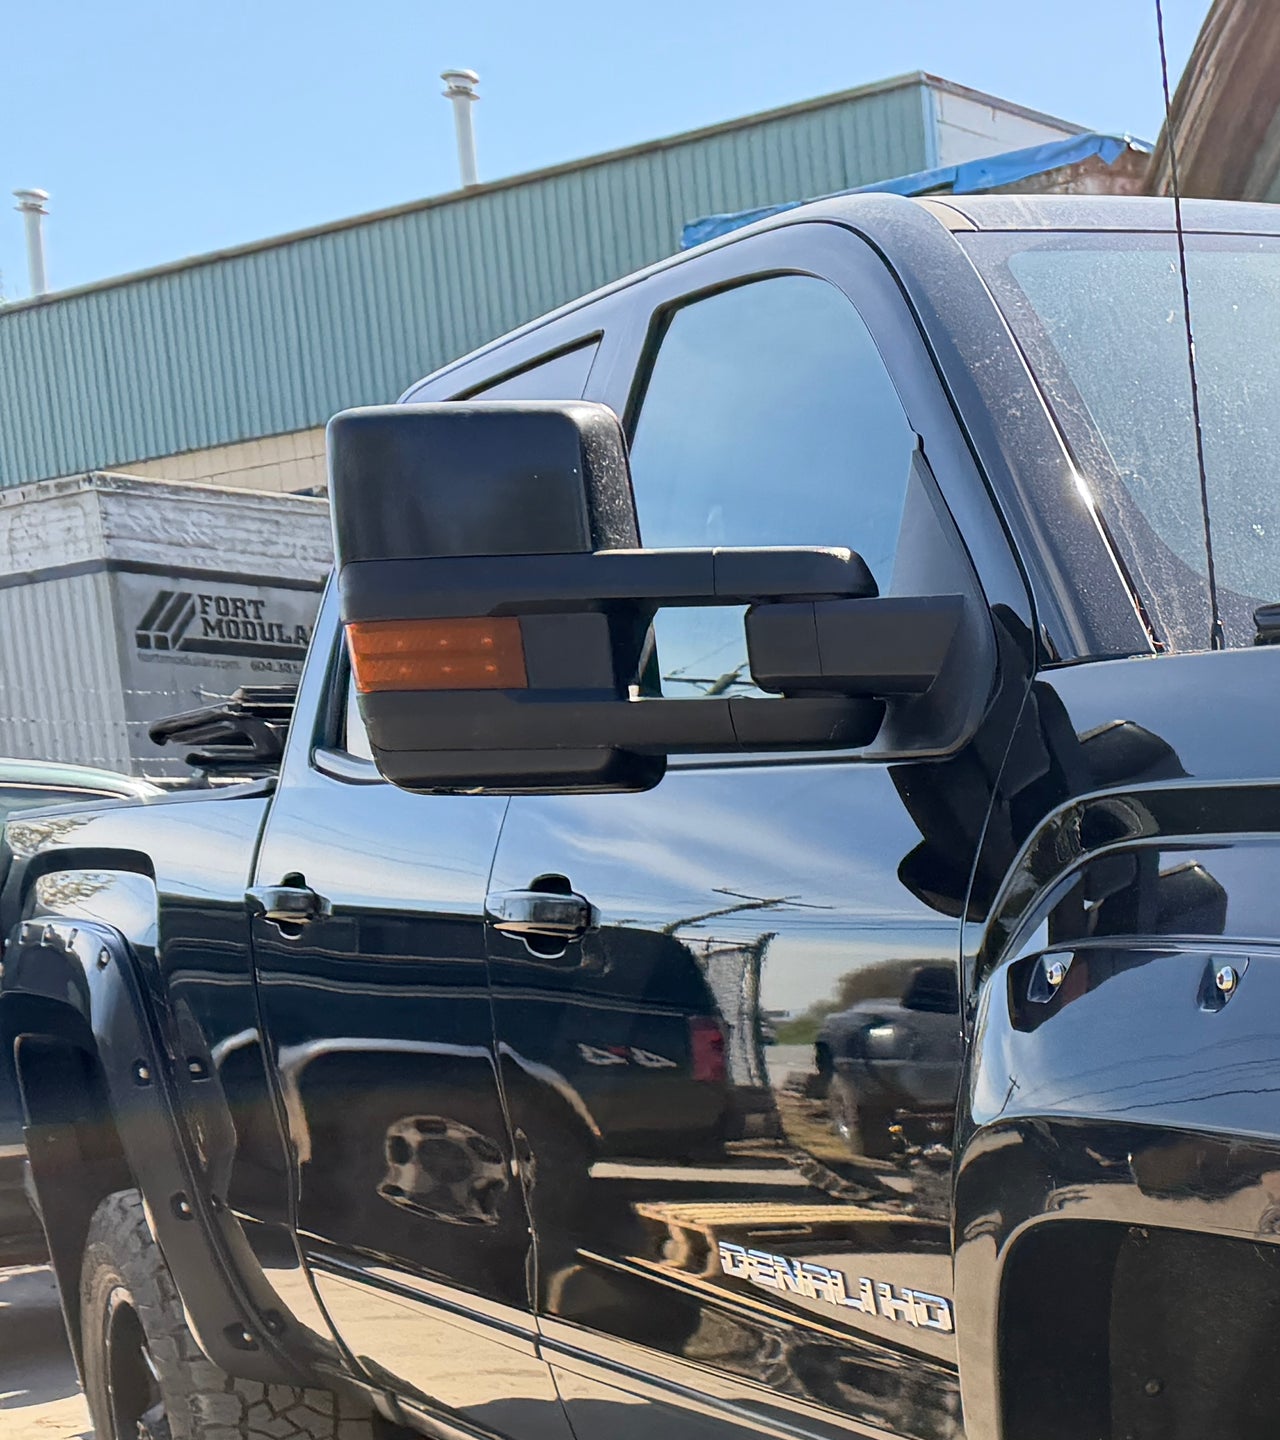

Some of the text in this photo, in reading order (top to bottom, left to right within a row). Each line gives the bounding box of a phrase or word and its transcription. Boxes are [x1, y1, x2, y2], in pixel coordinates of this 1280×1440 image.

[197, 594, 266, 621] FORT
[200, 616, 314, 646] MODULA
[718, 1240, 955, 1334] DENALI HD
